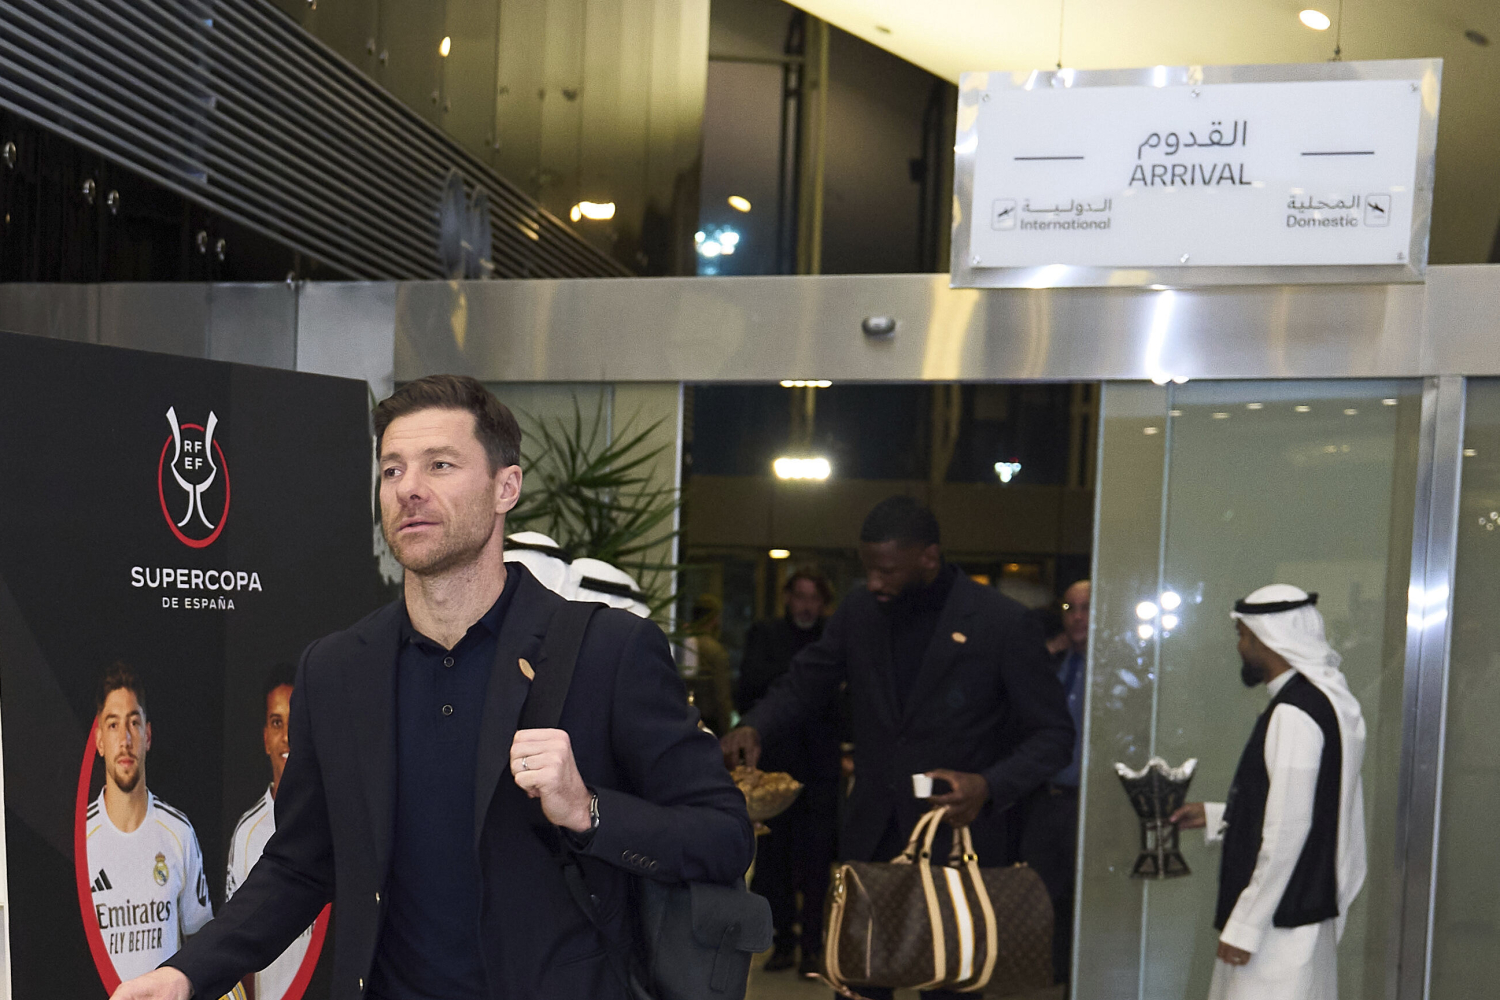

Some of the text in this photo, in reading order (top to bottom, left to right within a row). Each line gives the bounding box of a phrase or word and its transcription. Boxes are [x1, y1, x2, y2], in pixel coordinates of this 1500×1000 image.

[1137, 120, 1247, 160] القدوم
[1129, 163, 1252, 187] ARRIVAL
[1287, 194, 1360, 213] المحلية
[1020, 217, 1111, 231] International
[1286, 214, 1358, 228] Domestic
[131, 566, 262, 591] SUPERCOPA
[162, 596, 235, 609] DE ESPAÑA
[96, 899, 171, 929] Emirates
[110, 927, 162, 954] FLY BETTER
